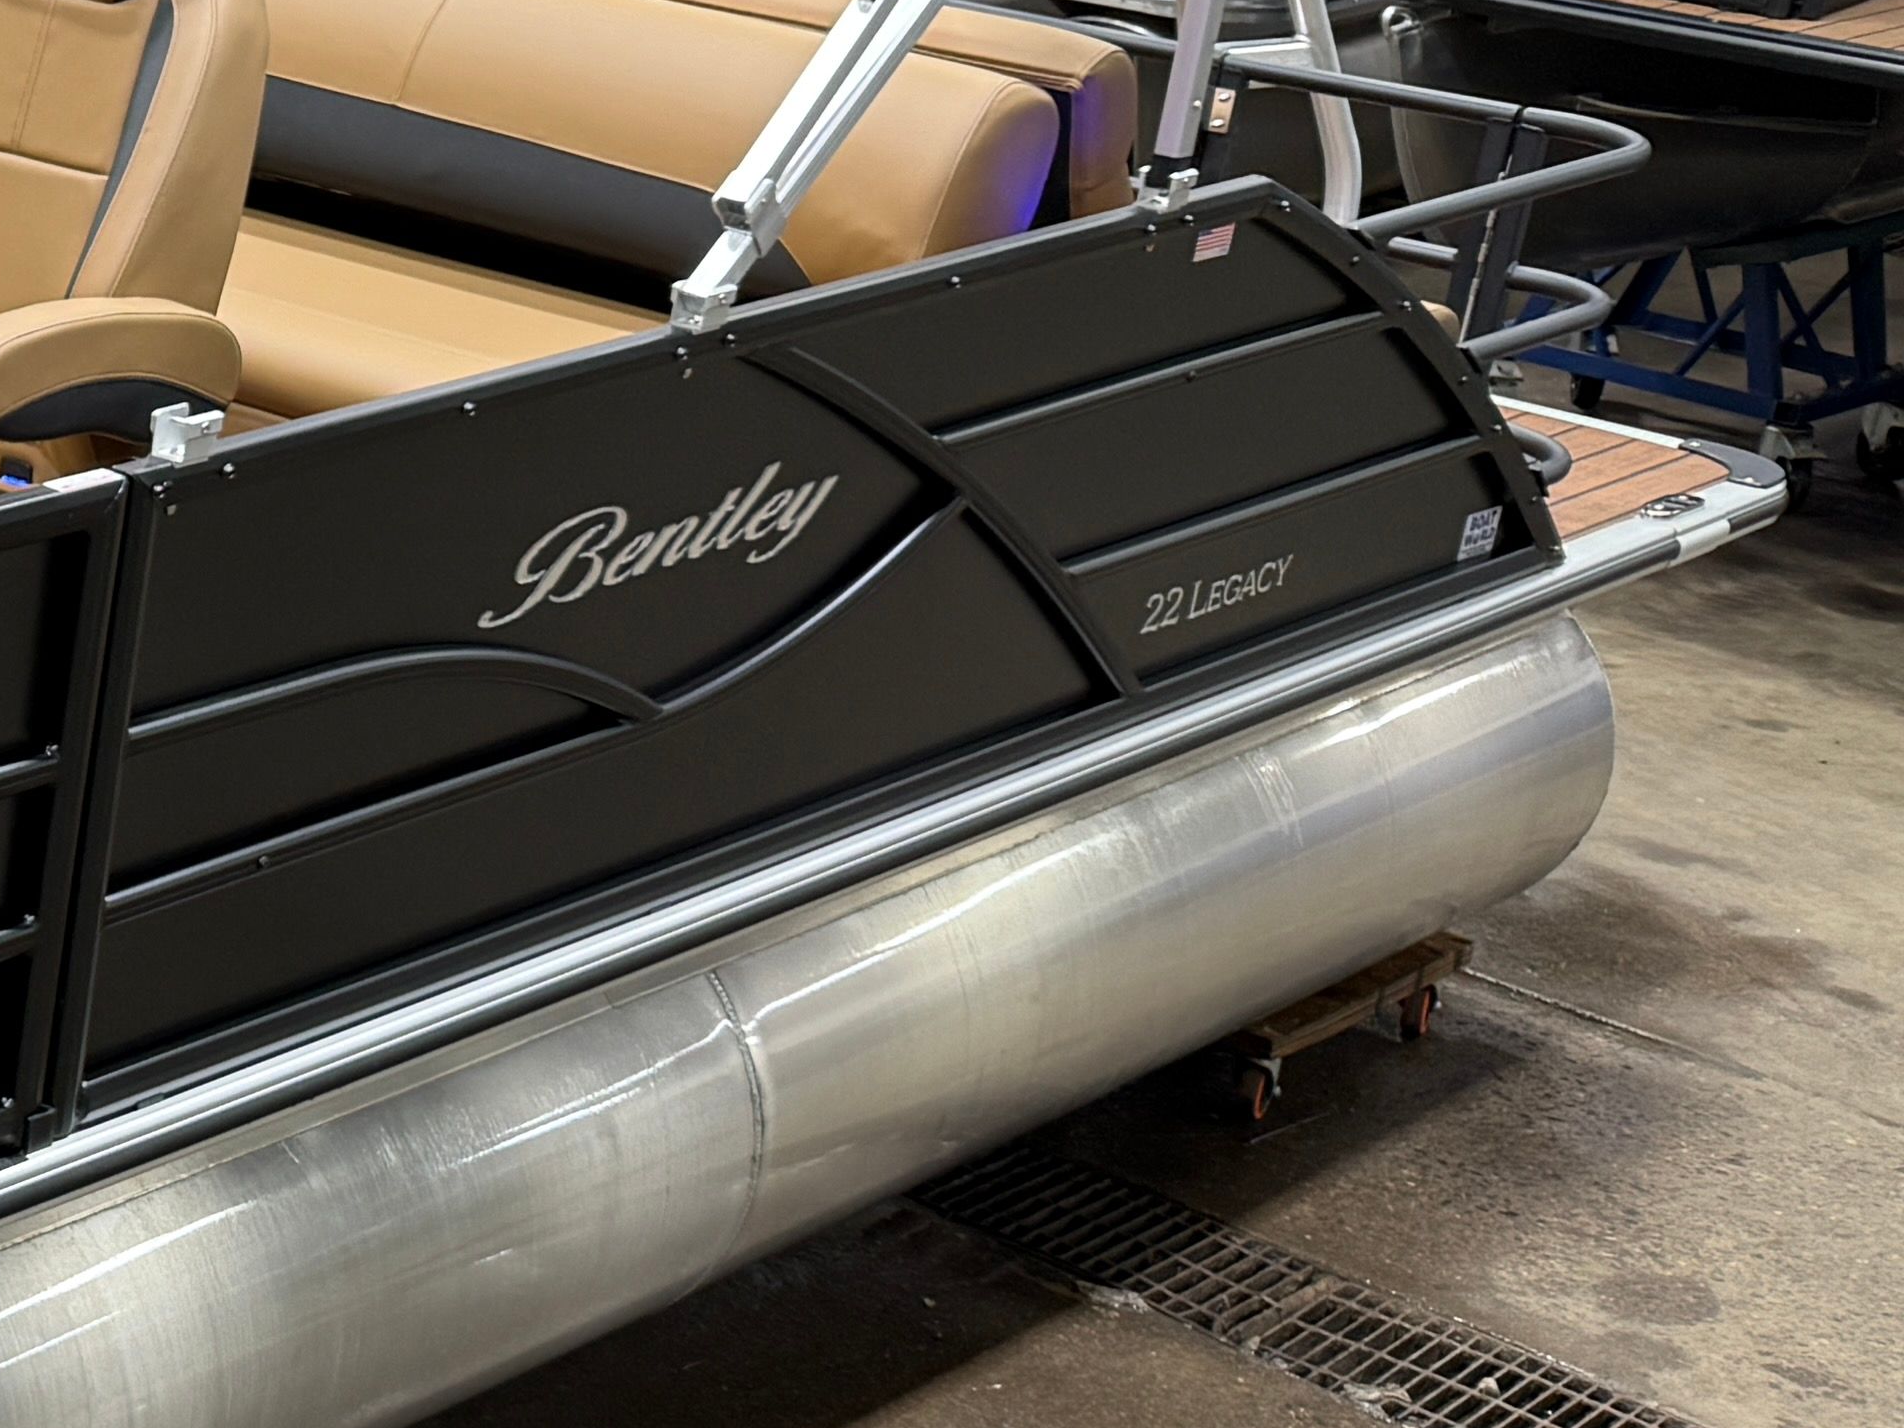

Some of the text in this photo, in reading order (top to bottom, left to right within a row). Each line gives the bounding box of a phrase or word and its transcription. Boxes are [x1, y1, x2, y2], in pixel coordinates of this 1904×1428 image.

[477, 460, 839, 630] Bentley
[1139, 553, 1294, 635] 22 LEGACY
